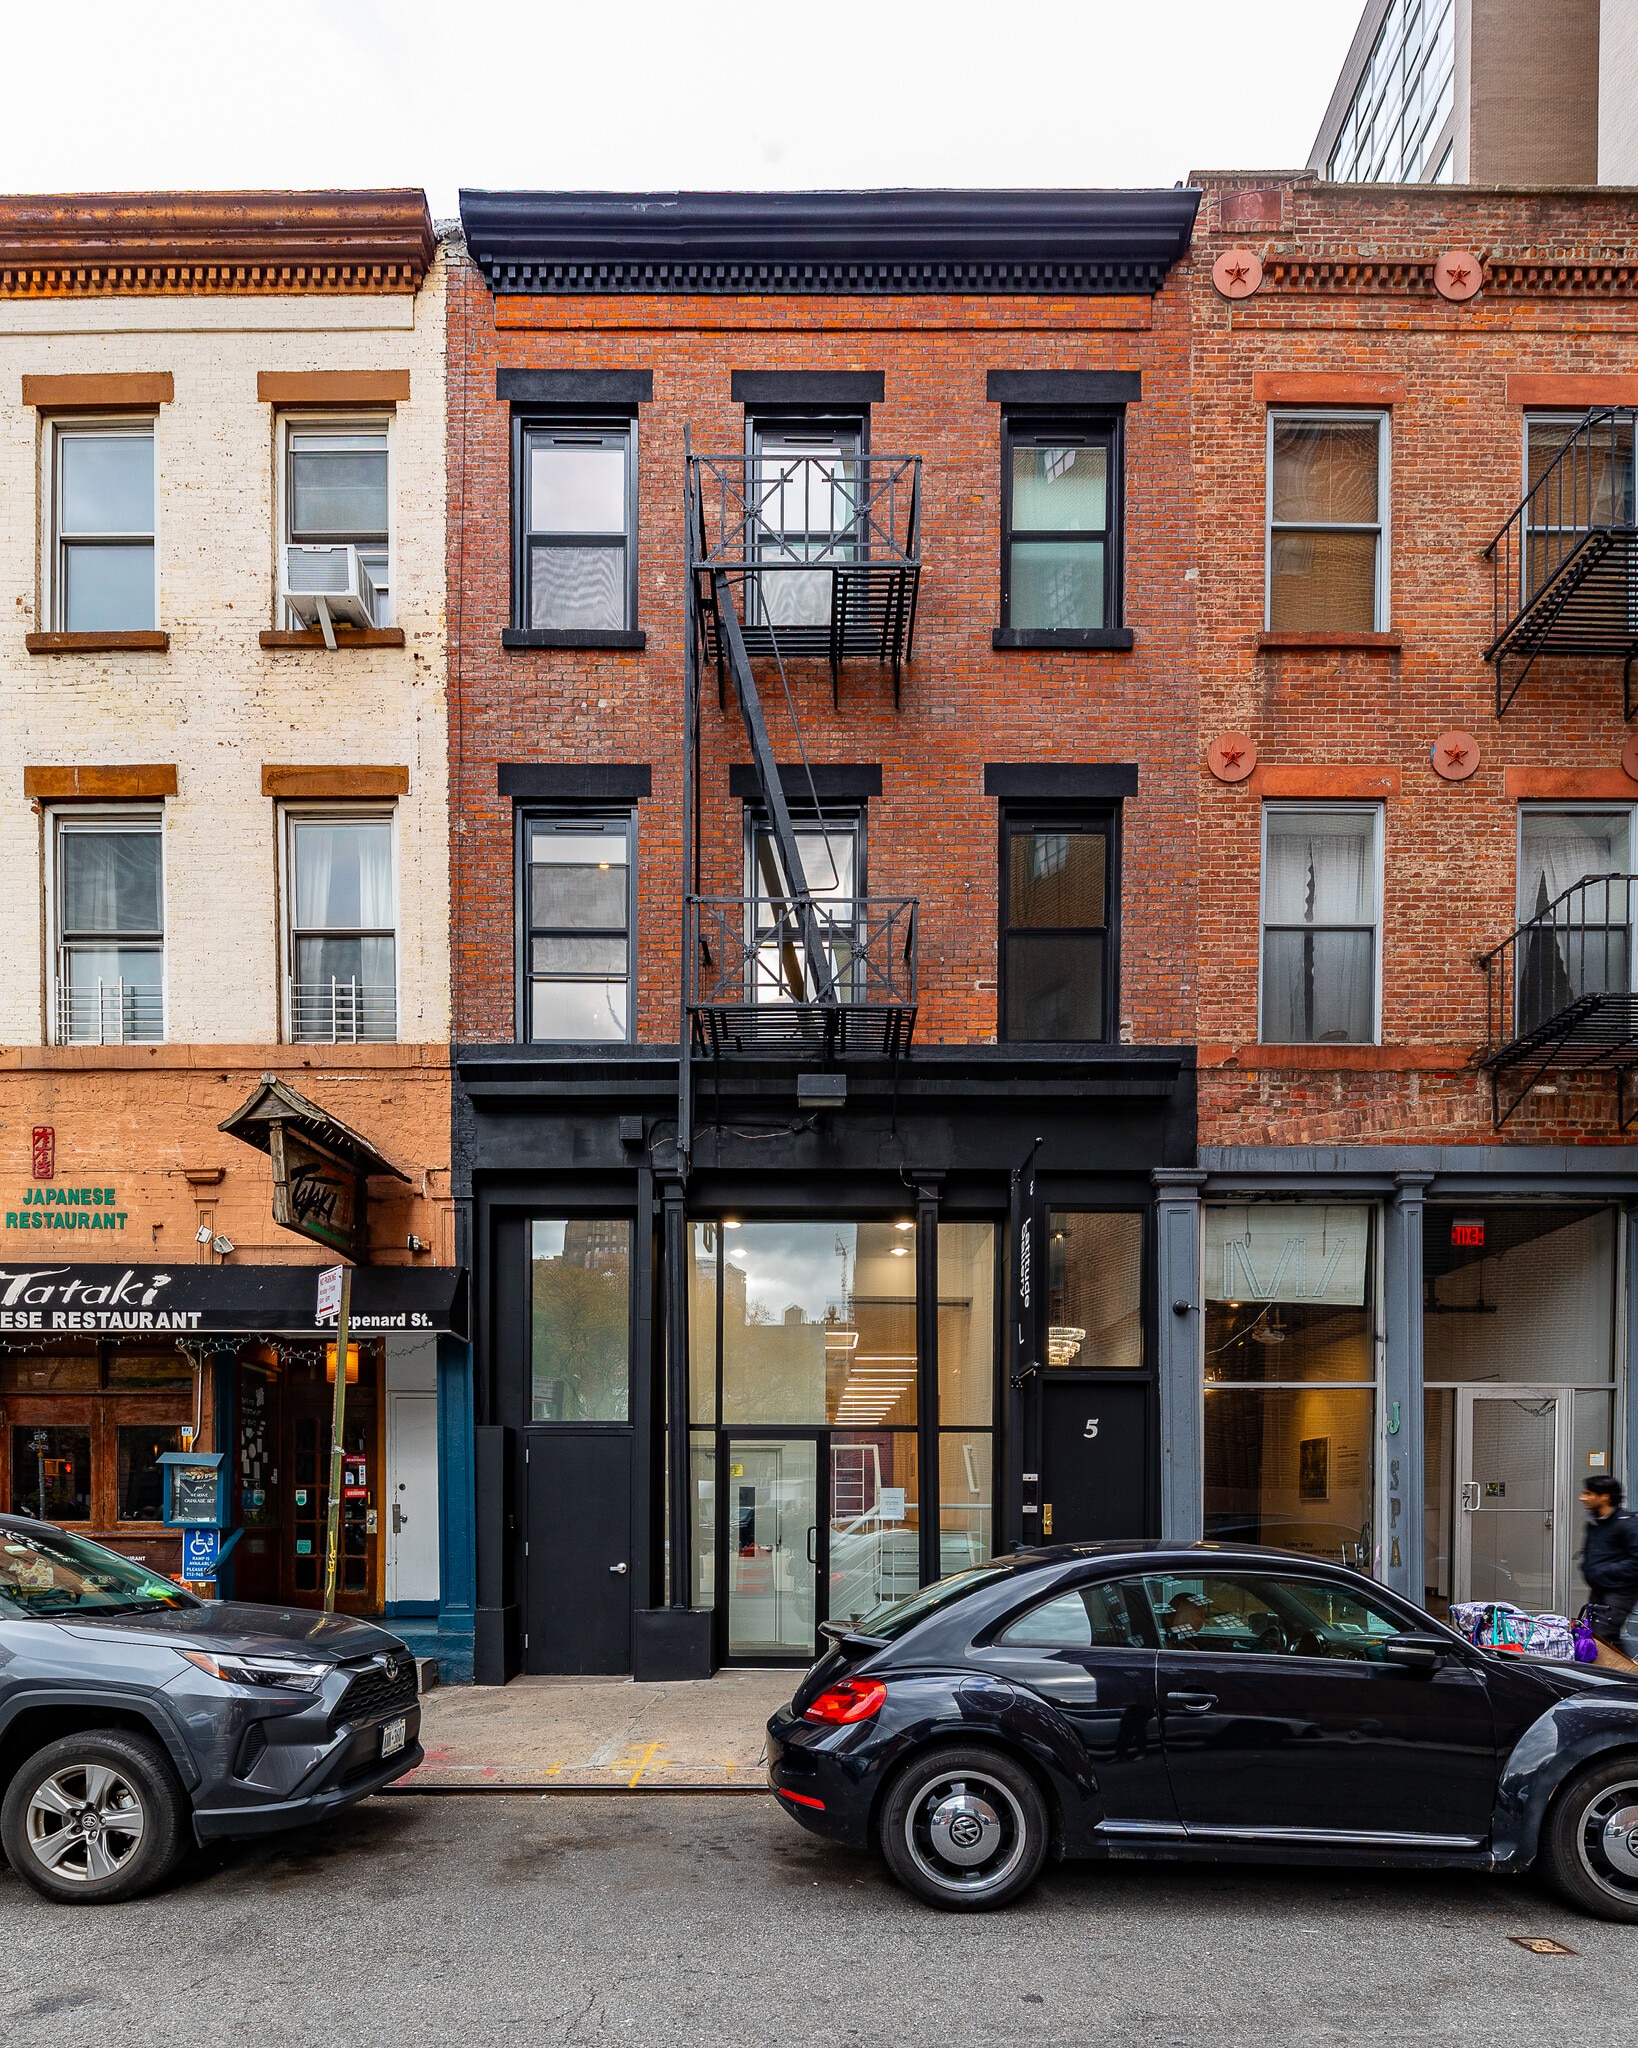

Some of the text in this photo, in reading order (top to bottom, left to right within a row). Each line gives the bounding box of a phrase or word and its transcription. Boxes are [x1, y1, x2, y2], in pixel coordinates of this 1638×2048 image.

[22, 1188, 116, 1206] JAPANESE
[5, 1212, 128, 1230] RESTAURANT
[0, 1266, 172, 1306] Tataki
[53, 1312, 202, 1329] RESTAURANT
[411, 1312, 433, 1327] St.
[1083, 1418, 1099, 1439] 5
[1462, 1496, 1470, 1508] 7
